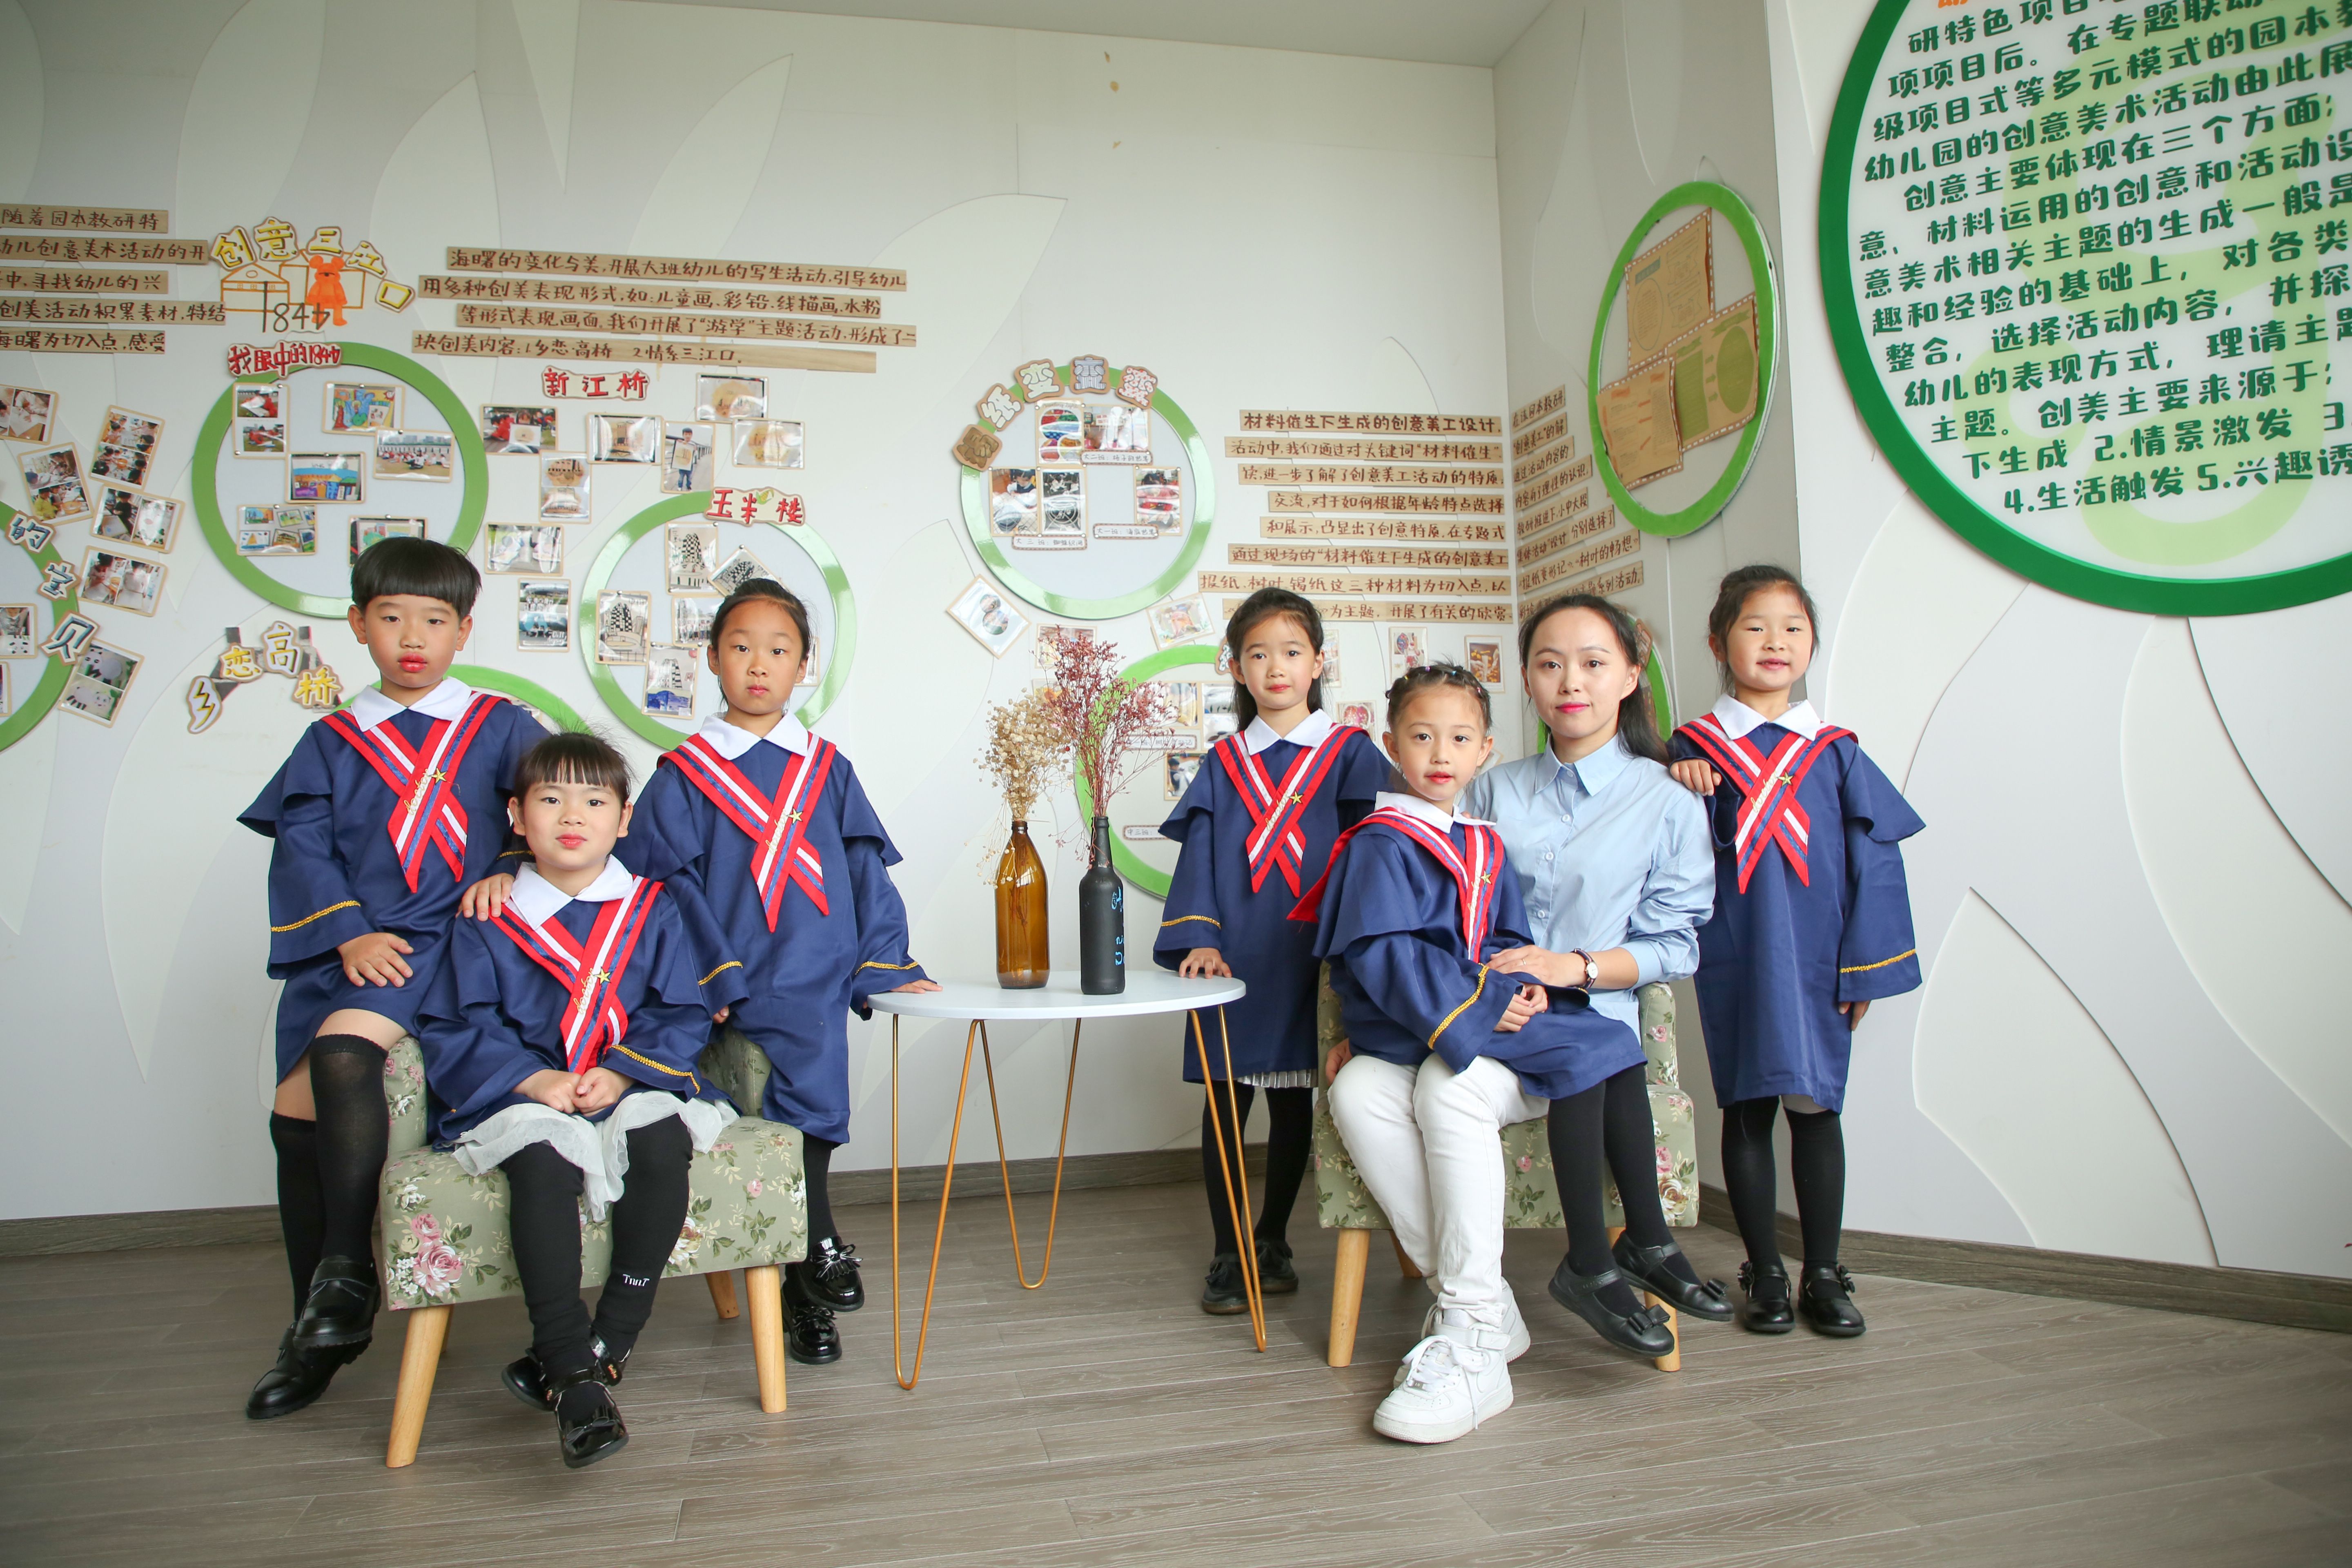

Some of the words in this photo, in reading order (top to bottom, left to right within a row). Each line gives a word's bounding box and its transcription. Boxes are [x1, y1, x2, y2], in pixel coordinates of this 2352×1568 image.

[1865, 40, 2352, 181] 幼儿园的创意美术活动由此展
[2, 207, 159, 231] 随着园本教研特
[218, 220, 412, 309] 创意三江口
[1865, 172, 2352, 298] 意美术相关主题的生成一般是
[544, 368, 648, 398] 新江桥
[193, 624, 341, 730] 乡恋高桥
